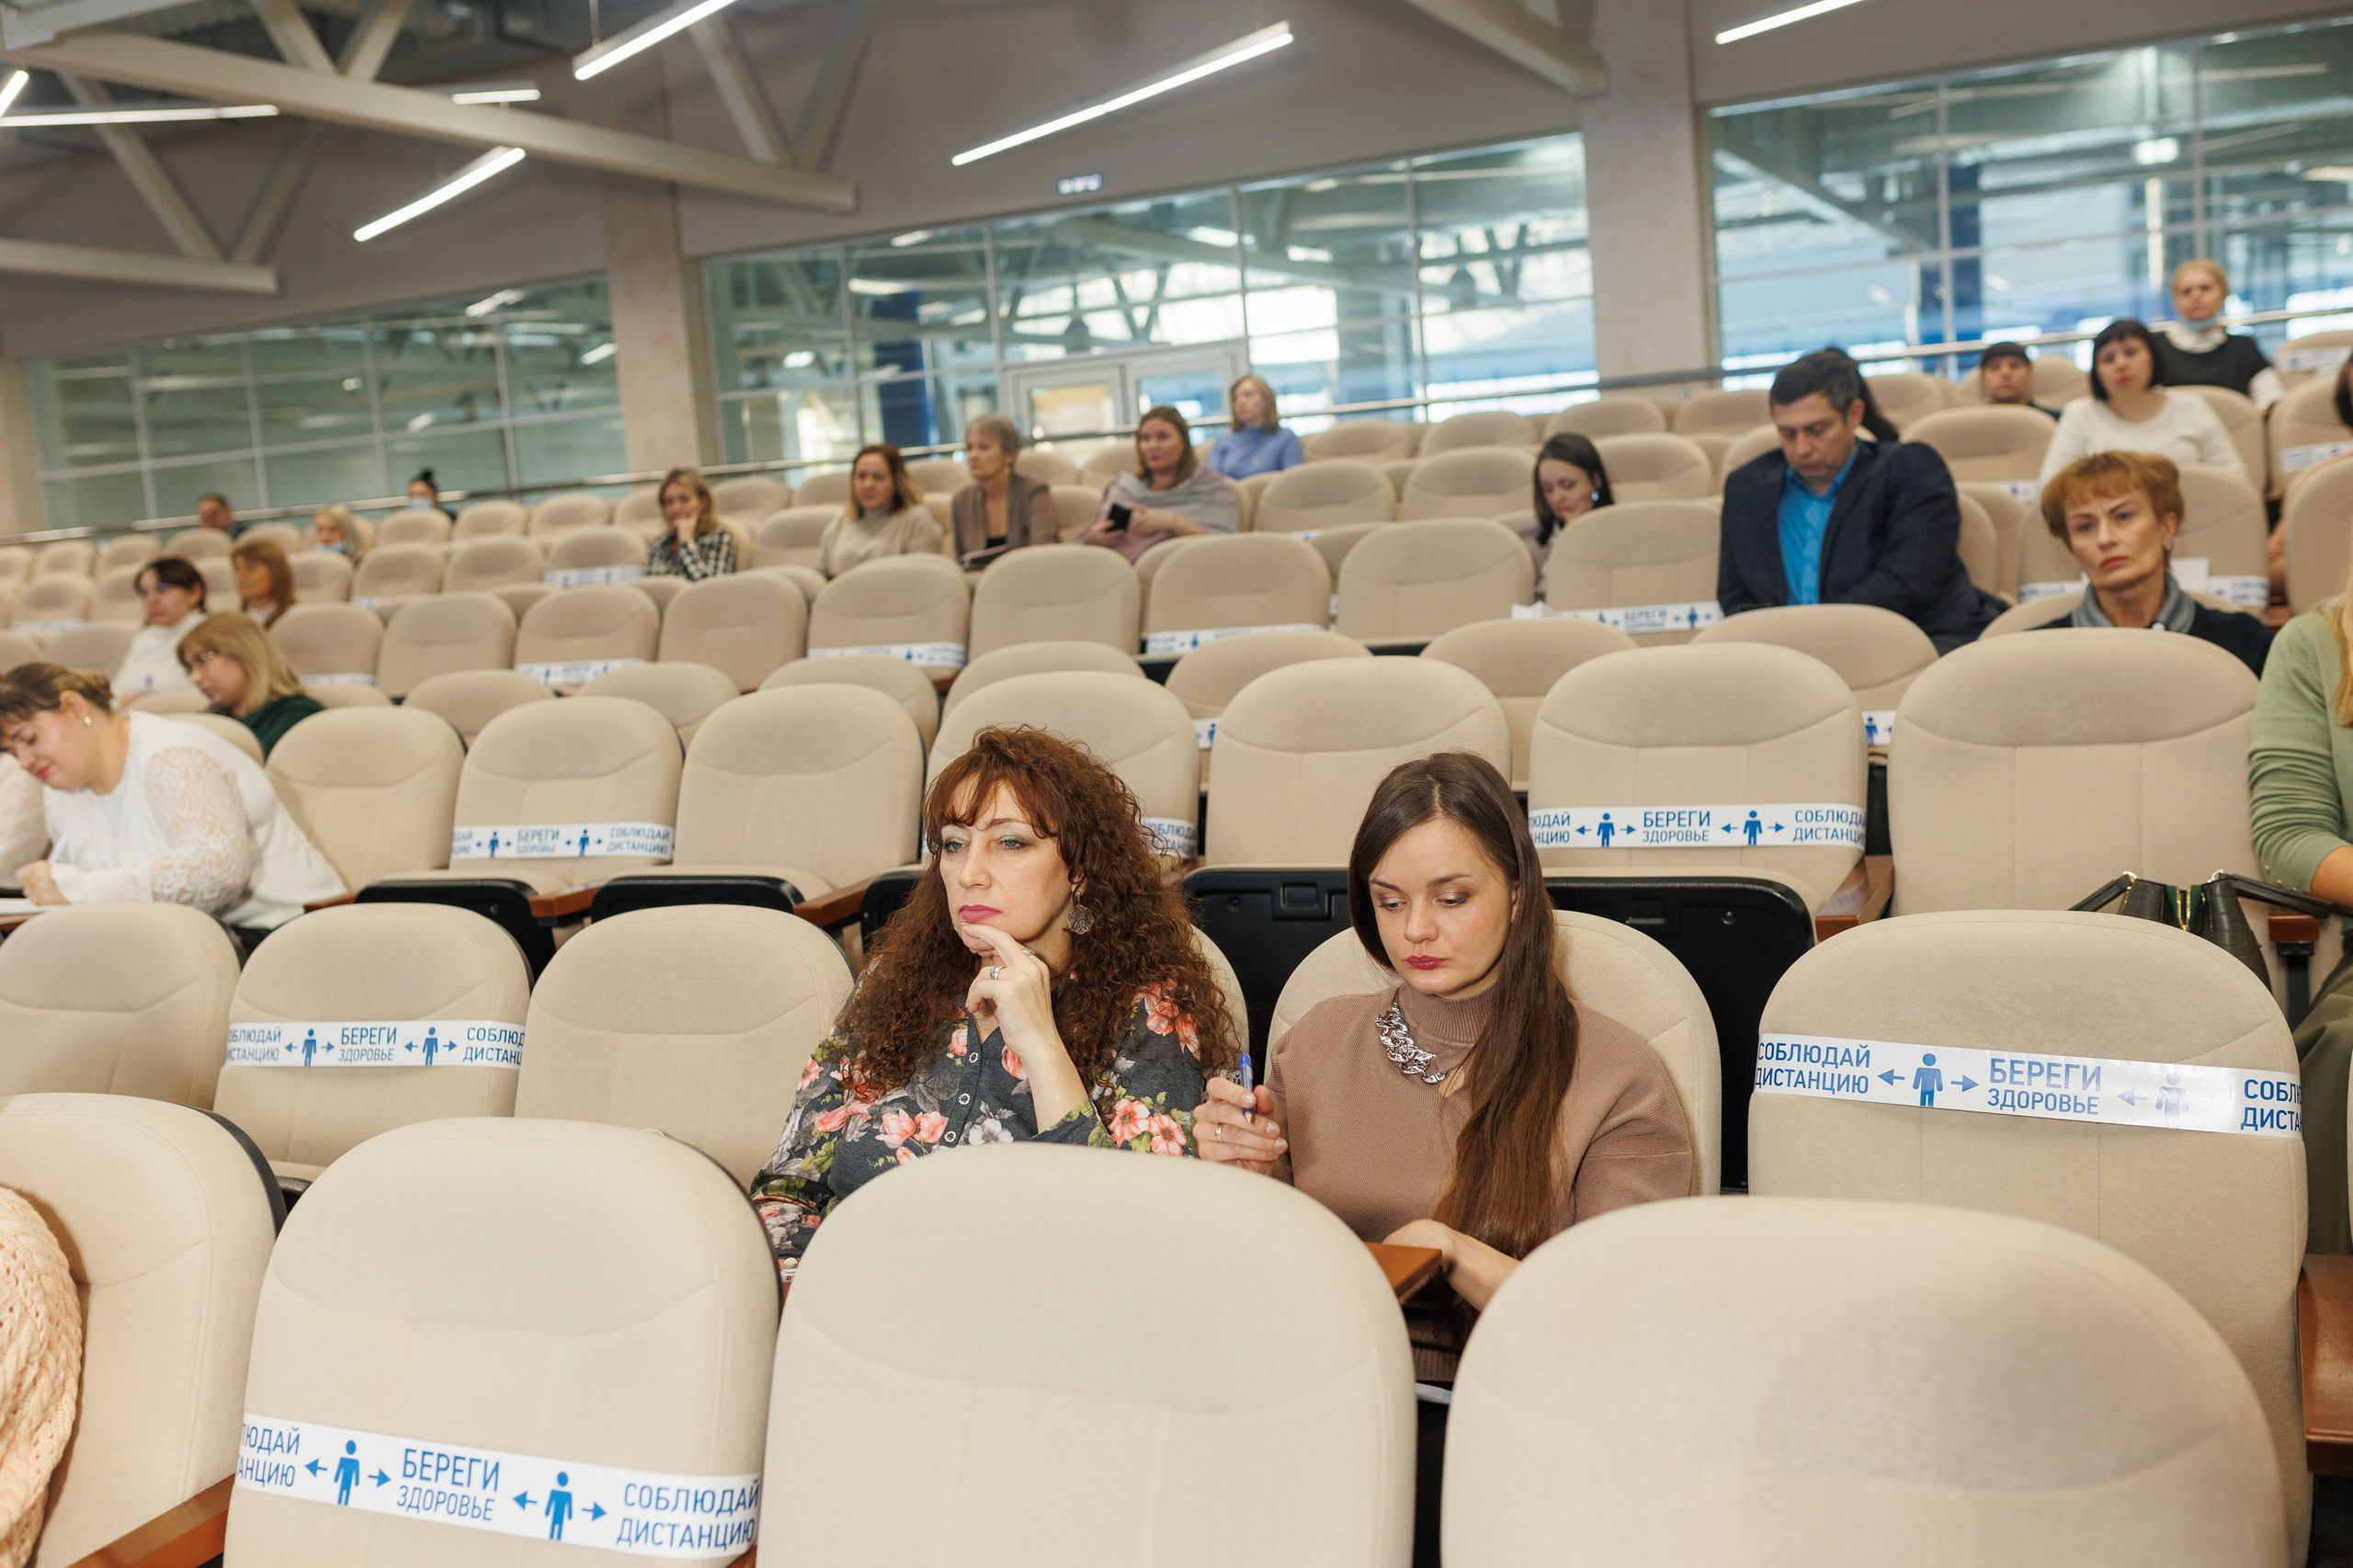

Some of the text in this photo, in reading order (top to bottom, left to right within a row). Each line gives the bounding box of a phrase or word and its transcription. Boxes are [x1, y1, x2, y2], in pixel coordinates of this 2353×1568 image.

[1529, 811, 1570, 828] ЮДАЙ
[1643, 811, 1711, 827] БЕРЕГИ
[517, 828, 559, 842] БЕРЕГИ
[609, 826, 670, 841] СОБЛЮДАЙ
[1642, 830, 1709, 844] ЗДОРОВЬЕ
[228, 1027, 281, 1044] ОБЛЮДАЙ
[341, 1027, 397, 1045] БЕРЕГИ
[467, 1027, 525, 1048] СОБЛЮД
[338, 1048, 394, 1063] ЗДОРОВЬЕ
[463, 1046, 522, 1066] ДИСТАНЦ
[1757, 1042, 1870, 1069] СОБЛЮДАЙ
[1755, 1067, 1870, 1095] ДИСТАНЦИЮ
[1989, 1058, 2101, 1092] БЕРЕГИ
[1987, 1087, 2099, 1115] ЗДОРОВЬЕ
[2244, 1079, 2302, 1105] СОБЛ
[2240, 1107, 2302, 1132] ДИСТА
[242, 1423, 301, 1456] ЮДАЙ
[237, 1455, 296, 1488] АНЦИЮ
[403, 1448, 500, 1492] БЕРЕГИ
[396, 1484, 495, 1521] ЗДОРОВЬЕ
[623, 1478, 760, 1517] СОБЛЮДАЙ
[616, 1517, 756, 1551] ДИСТАНЦИЮ
